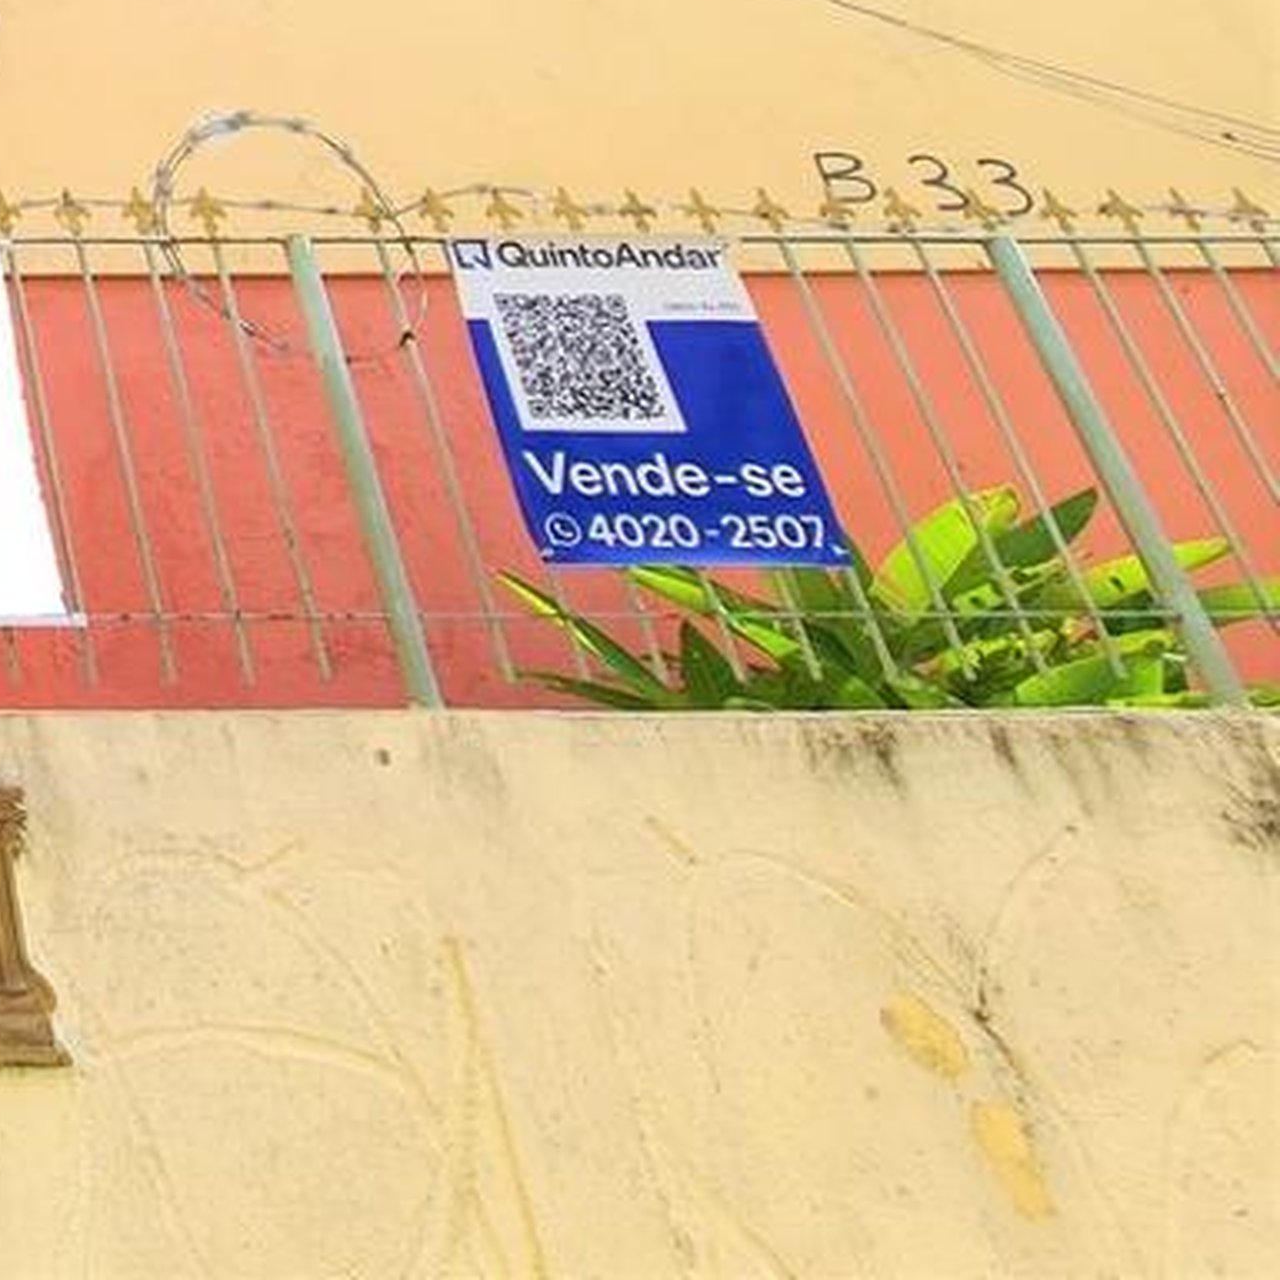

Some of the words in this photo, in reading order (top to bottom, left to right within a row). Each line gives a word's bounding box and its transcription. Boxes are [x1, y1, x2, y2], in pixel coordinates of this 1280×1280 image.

[496, 241, 722, 271] QuintoAndar
[523, 450, 806, 497] Vende-se
[587, 514, 825, 549] 4020-2507
